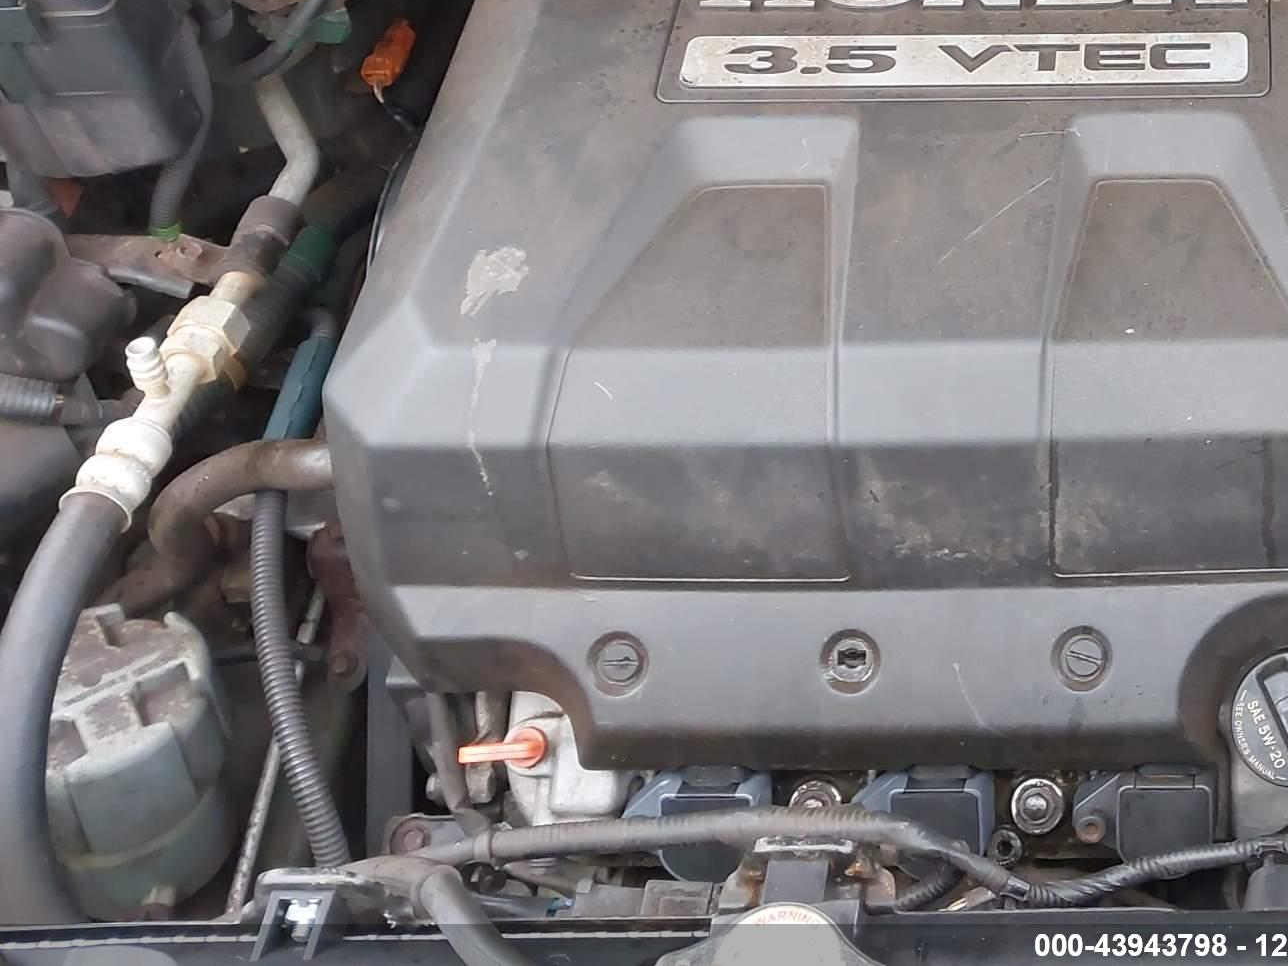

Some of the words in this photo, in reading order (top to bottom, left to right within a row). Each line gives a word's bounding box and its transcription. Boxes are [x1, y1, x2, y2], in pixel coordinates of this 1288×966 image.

[724, 44, 898, 75] 3.5
[940, 42, 1213, 74] VTEC
[1234, 702, 1244, 717] SEE
[1248, 755, 1276, 780] MANUAL
[1247, 700, 1266, 724] SAE
[1258, 724, 1286, 769] 5W-20
[752, 909, 822, 930] WARNING
